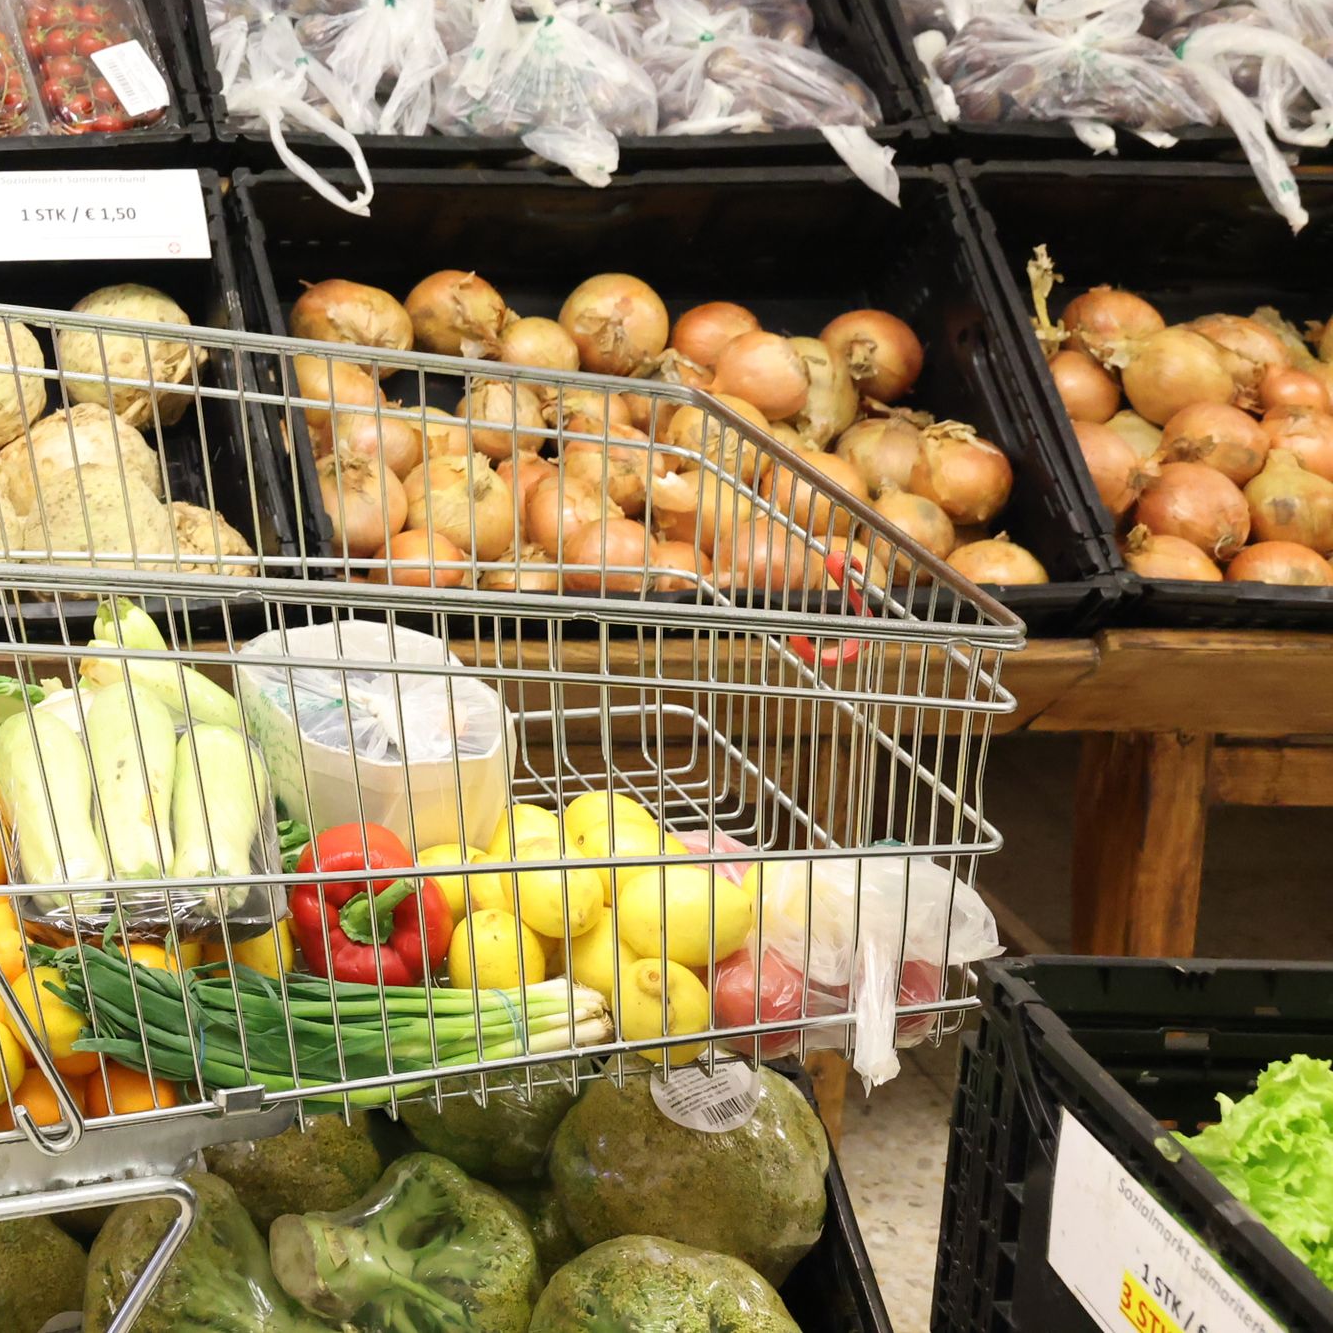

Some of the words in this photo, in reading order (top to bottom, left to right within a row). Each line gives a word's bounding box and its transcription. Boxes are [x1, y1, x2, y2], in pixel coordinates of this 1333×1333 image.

[0, 175, 63, 185] Sozialmarkt
[21, 208, 30, 222] 1
[35, 208, 66, 222] STK
[85, 207, 95, 221] €
[101, 207, 137, 223] 1,50
[1118, 1177, 1191, 1263] Sozialmarkt
[1120, 1281, 1132, 1311] 3
[1141, 1264, 1149, 1285] 1
[1153, 1276, 1182, 1320] STK
[1183, 1310, 1195, 1331] /
